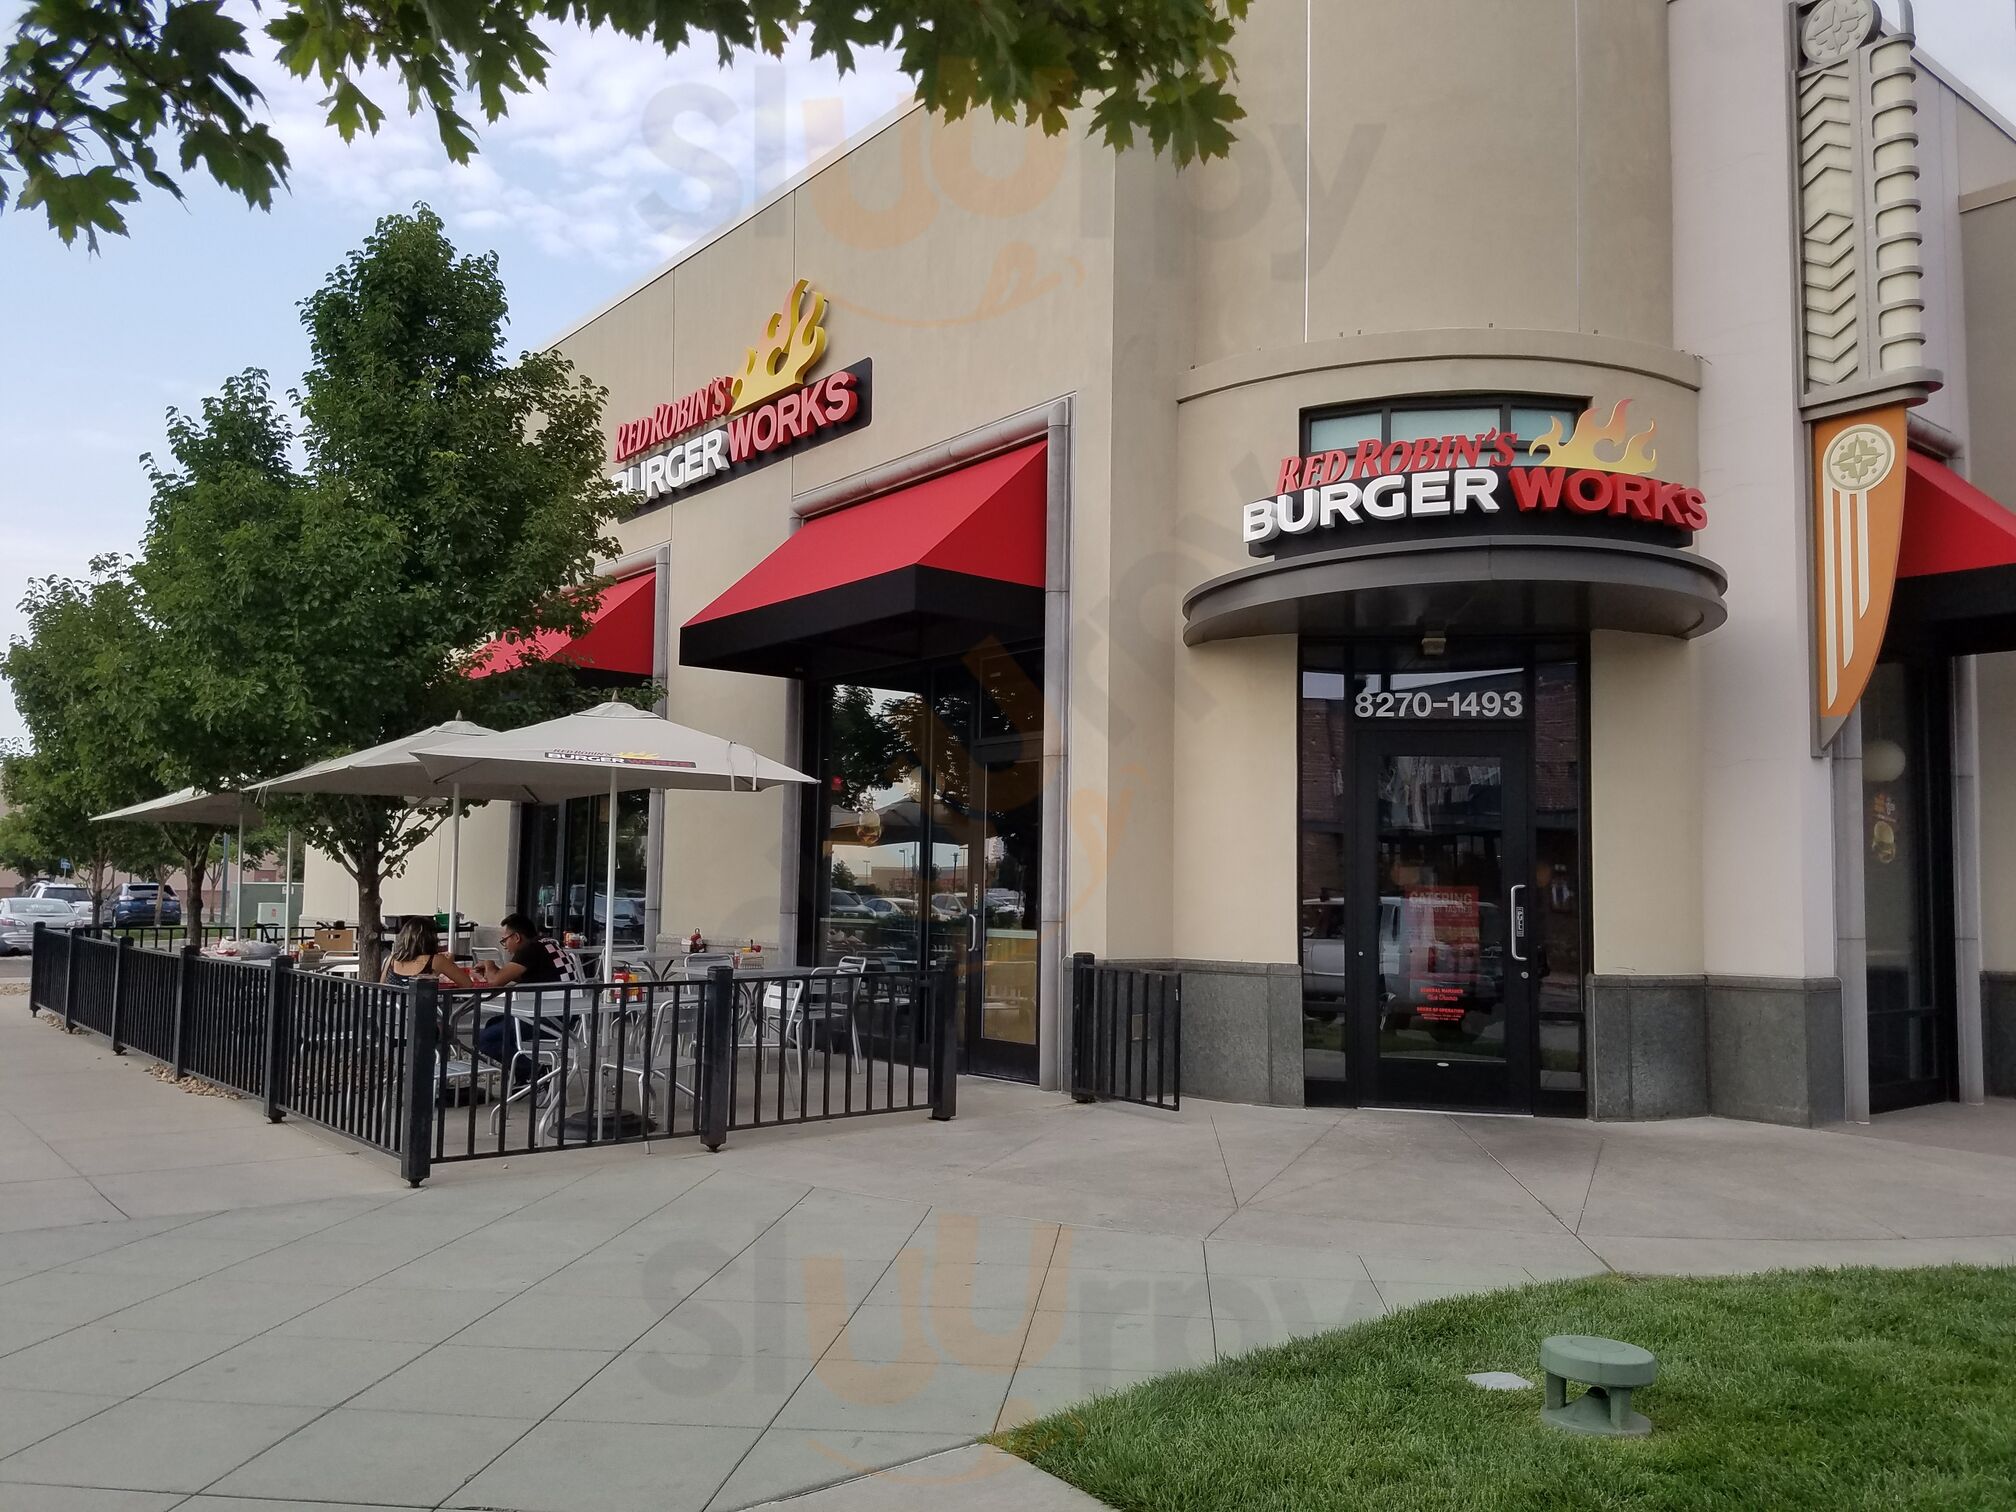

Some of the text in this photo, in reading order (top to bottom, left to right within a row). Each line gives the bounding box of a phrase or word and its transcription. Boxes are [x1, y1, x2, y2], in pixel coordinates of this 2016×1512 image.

[613, 376, 734, 463] RED ROBIN'S
[727, 371, 859, 463] WORKS
[1274, 426, 1519, 497] RED ROBIN'S
[1242, 466, 1709, 544] BURGER WORKS
[1354, 691, 1524, 718] 8270-1493
[547, 752, 692, 768] BURGER WORKS
